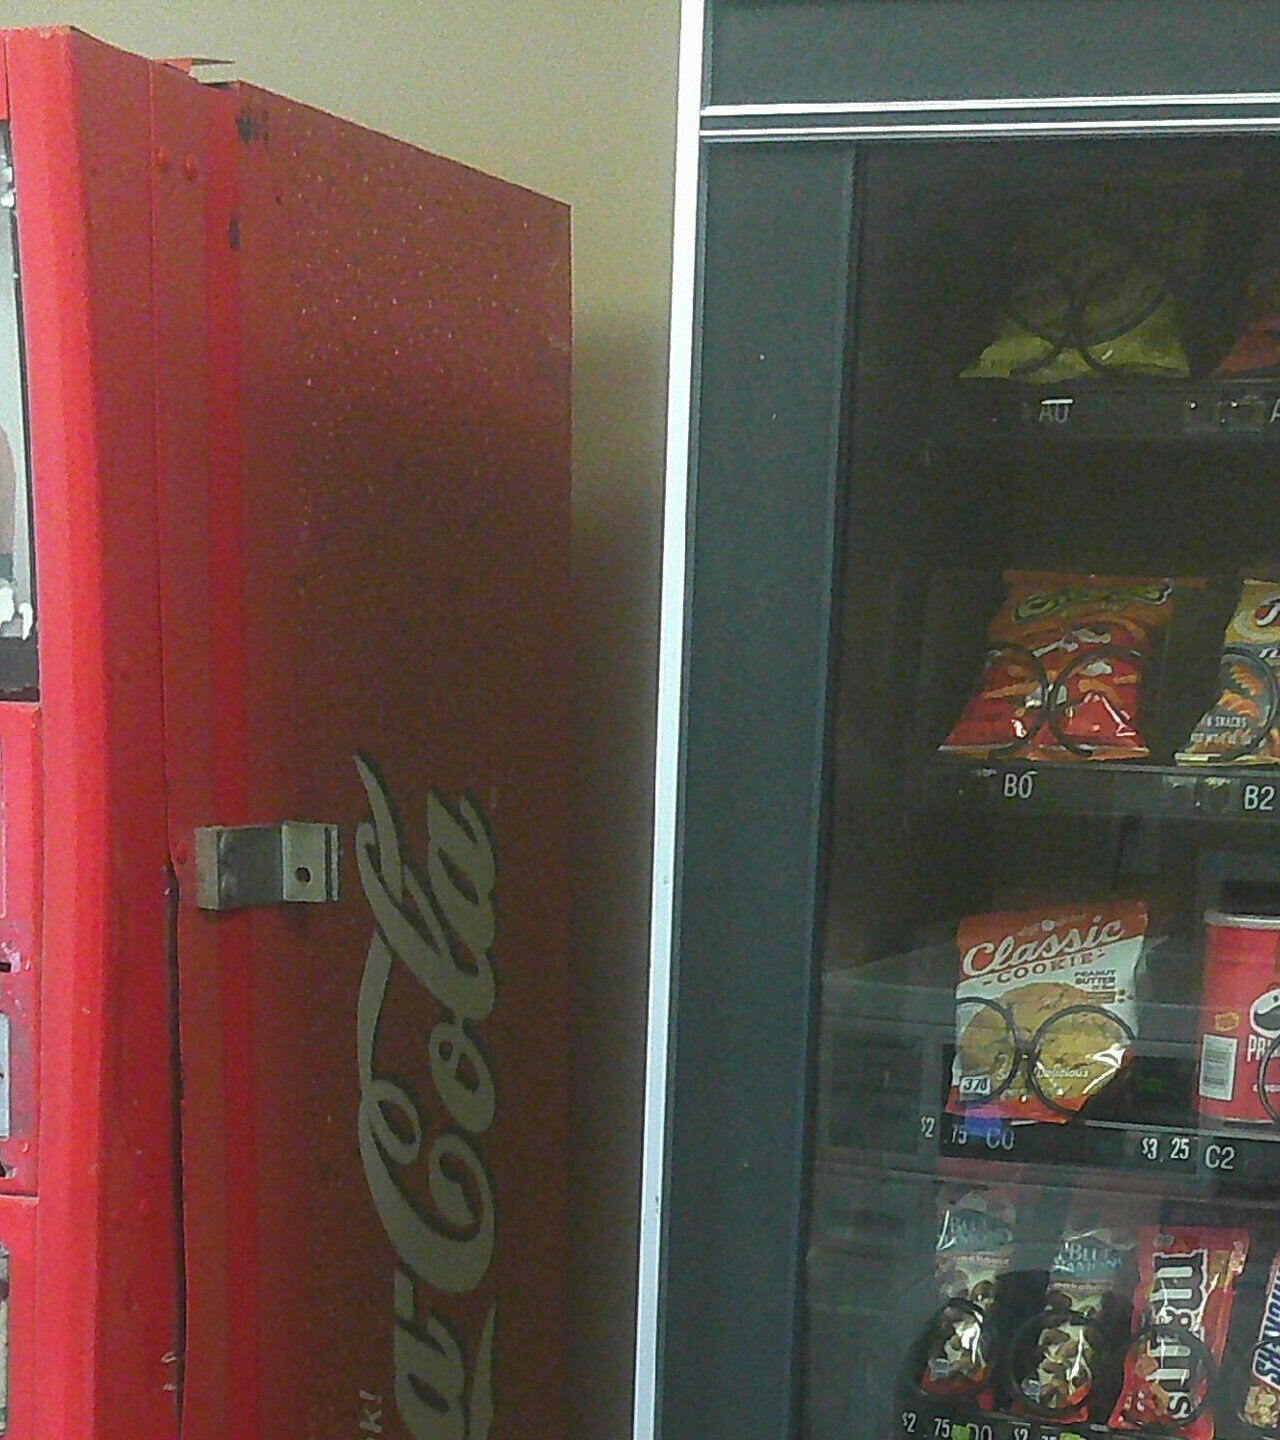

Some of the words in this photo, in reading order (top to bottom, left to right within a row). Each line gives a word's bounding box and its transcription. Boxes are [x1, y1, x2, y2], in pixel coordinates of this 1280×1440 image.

[1004, 773, 1033, 799] B0
[1244, 785, 1276, 812] B2
[963, 915, 1124, 976] Classic
[1075, 969, 1116, 977] PEANUT
[1204, 1145, 1235, 1170] C2
